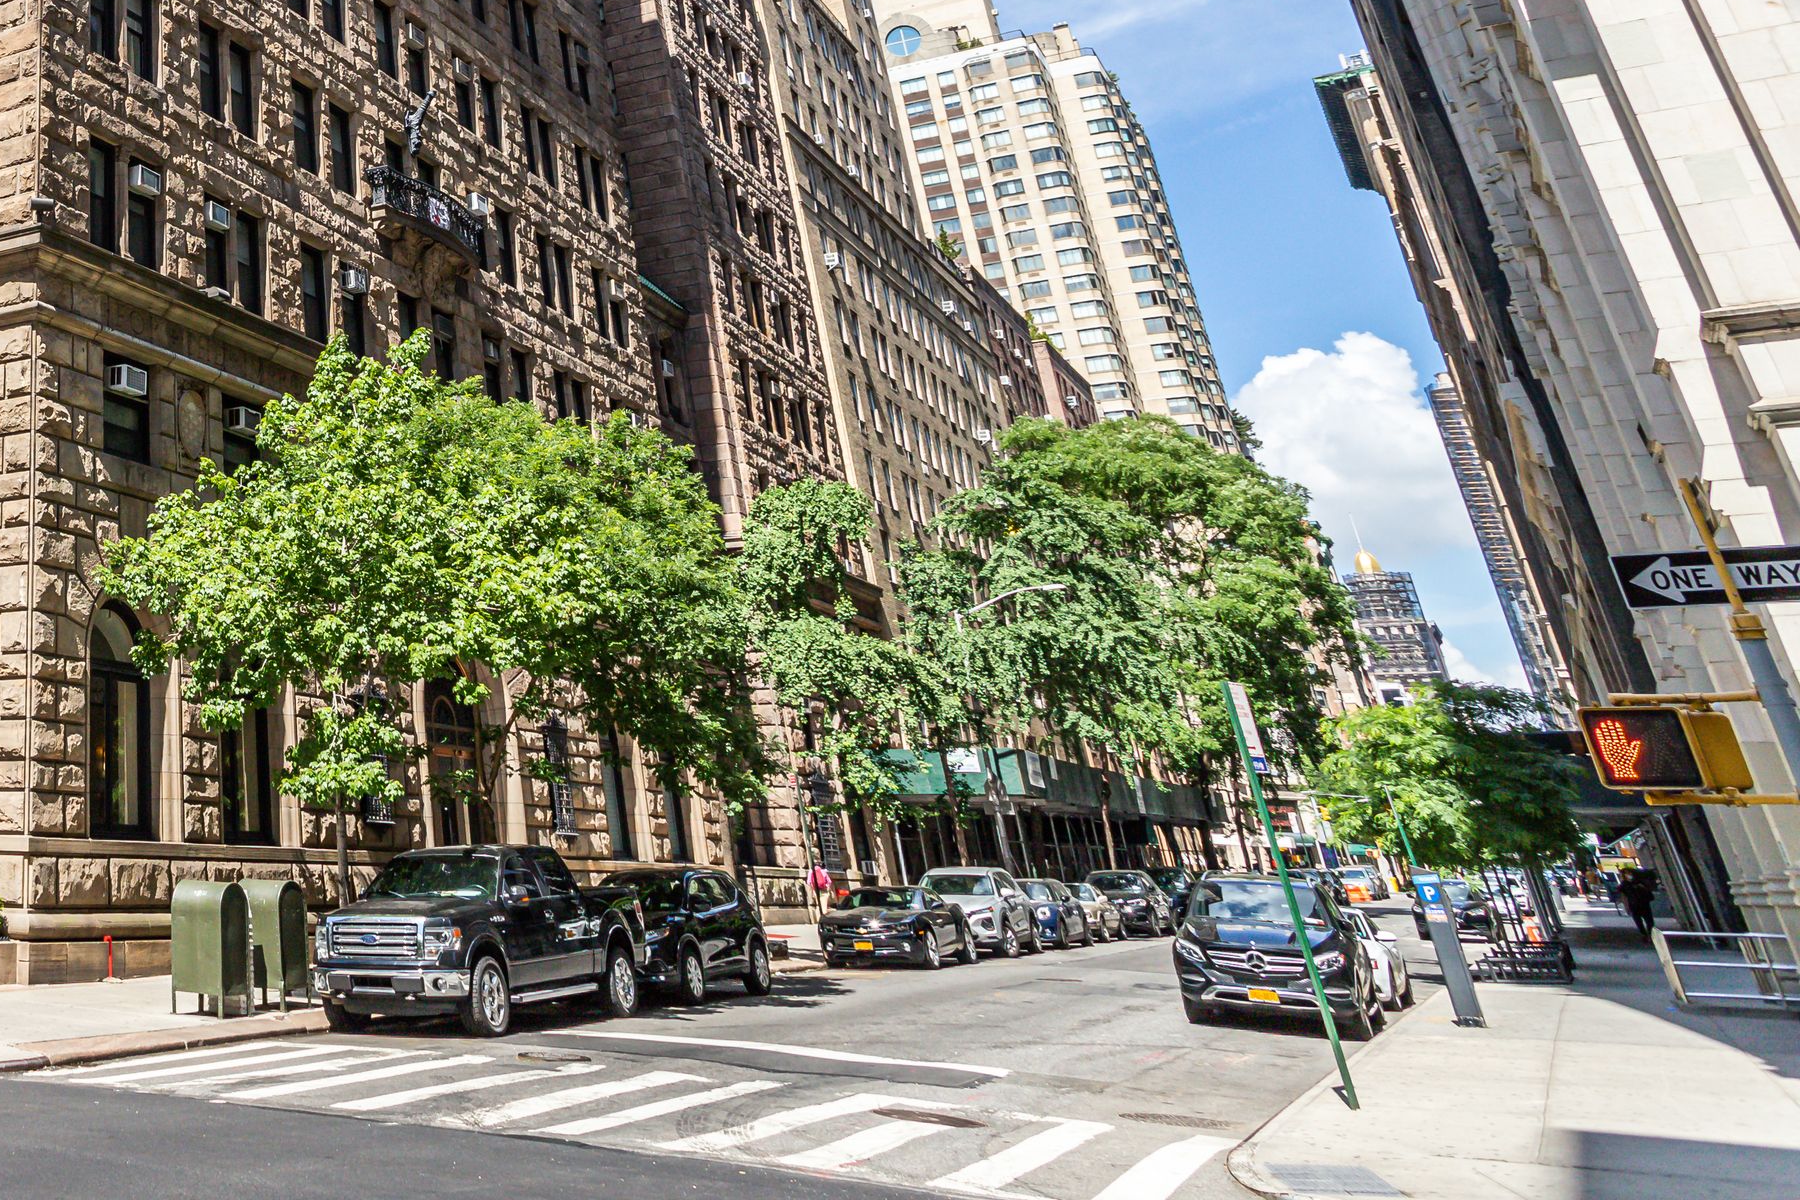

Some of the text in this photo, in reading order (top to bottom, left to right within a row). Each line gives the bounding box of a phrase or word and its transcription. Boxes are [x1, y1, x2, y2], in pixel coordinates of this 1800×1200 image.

[1650, 562, 1800, 591] ONE WAY
[1422, 885, 1436, 901] P
